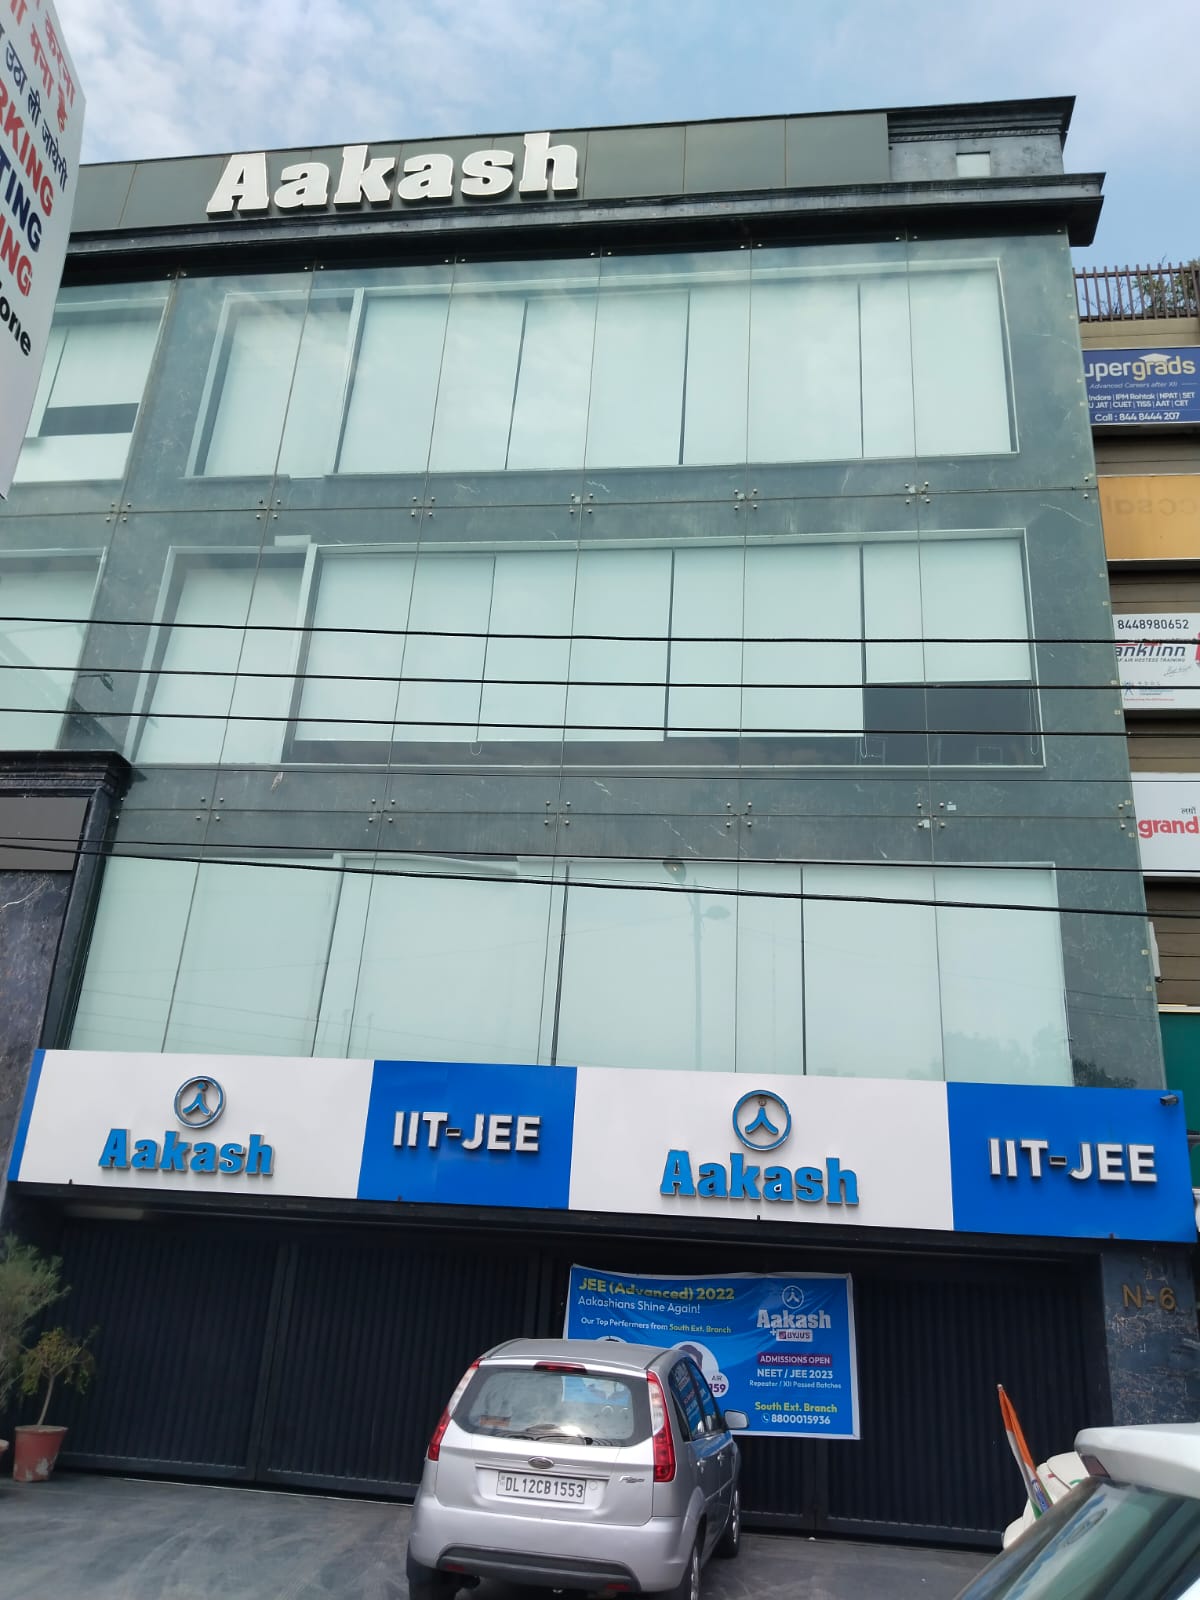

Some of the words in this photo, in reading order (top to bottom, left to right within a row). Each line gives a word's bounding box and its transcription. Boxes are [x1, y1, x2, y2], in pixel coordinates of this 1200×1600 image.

[31, 22, 54, 99] मना
[6, 40, 28, 96] उठा
[28, 86, 41, 128] ली
[206, 132, 579, 215] Aakash
[0, 281, 31, 356] one
[1095, 413, 1113, 421] Call
[1119, 413, 1137, 421] 844
[1139, 412, 1162, 420] 8444
[1163, 412, 1180, 420] 207
[1117, 619, 1189, 630] 8448980652
[1138, 816, 1199, 838] grand
[392, 1111, 542, 1152] IIT-JEE
[98, 1127, 275, 1177] Aakash
[988, 1137, 1159, 1184] IIT-JEE
[659, 1149, 860, 1205] Aakash
[579, 1278, 607, 1292] JEE
[609, 1283, 693, 1300] (Advanced)
[695, 1288, 735, 1300] 2022
[1121, 1284, 1176, 1311] N-6
[578, 1295, 635, 1310] Aakashians
[637, 1300, 665, 1312] Shine
[667, 1302, 701, 1315] Again!
[580, 1316, 594, 1325] Our
[596, 1317, 608, 1326] Top
[609, 1318, 649, 1329] Performers
[650, 1320, 668, 1330] from
[669, 1323, 690, 1332] South
[691, 1324, 705, 1332] Ext.
[706, 1325, 731, 1334] Branch
[757, 1309, 832, 1328] Aakash
[760, 1355, 807, 1364] ADMISSIONS
[808, 1356, 830, 1364] OPEN
[749, 1380, 778, 1388] Repeater
[816, 1381, 841, 1389] Batches
[757, 1368, 783, 1378] NEET
[790, 1369, 808, 1378] JEE
[809, 1370, 833, 1379] 2023
[755, 1401, 782, 1411] South
[783, 1402, 802, 1412] Ext.
[804, 1403, 838, 1413] Branch
[771, 1414, 831, 1424] 8800015936
[505, 1476, 584, 1498] DL12CB1553
